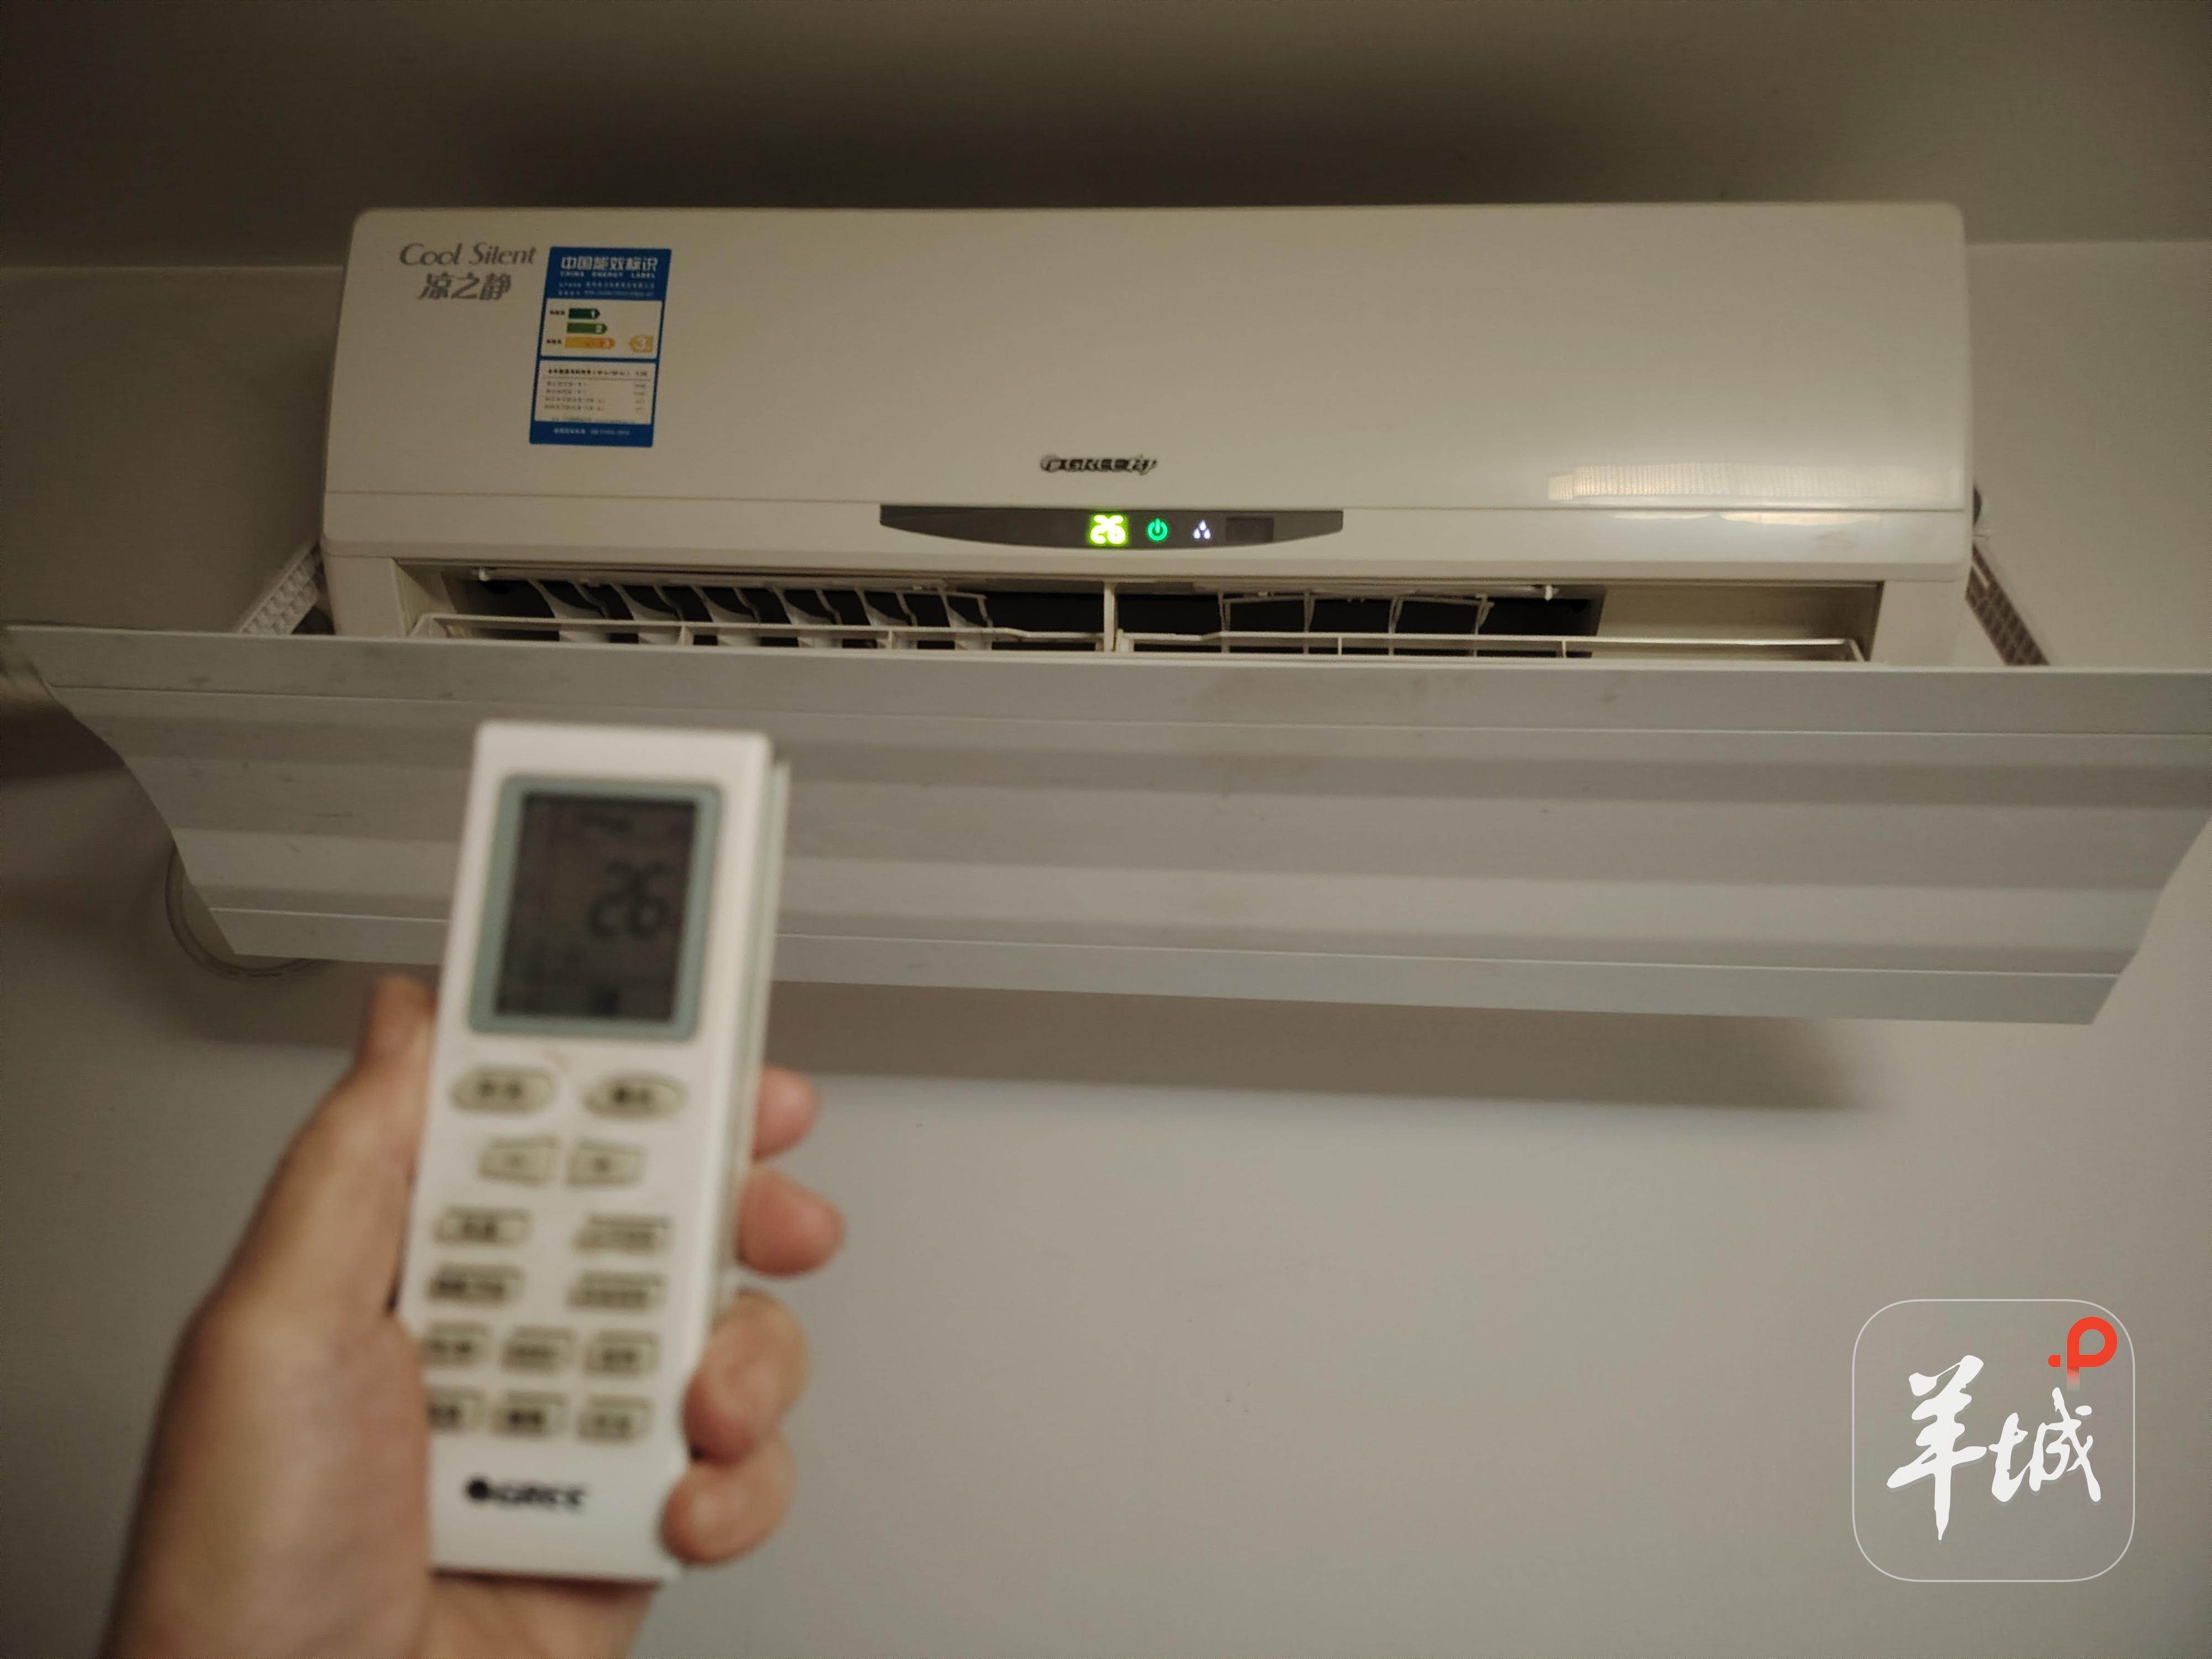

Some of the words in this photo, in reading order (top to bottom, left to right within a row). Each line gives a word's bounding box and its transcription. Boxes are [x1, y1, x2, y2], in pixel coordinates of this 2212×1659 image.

[399, 243, 463, 265] Cool
[469, 242, 536, 265] Silent
[561, 256, 658, 272] 中国能效标识
[417, 272, 512, 300] 凉之静
[1089, 514, 1126, 545] 26
